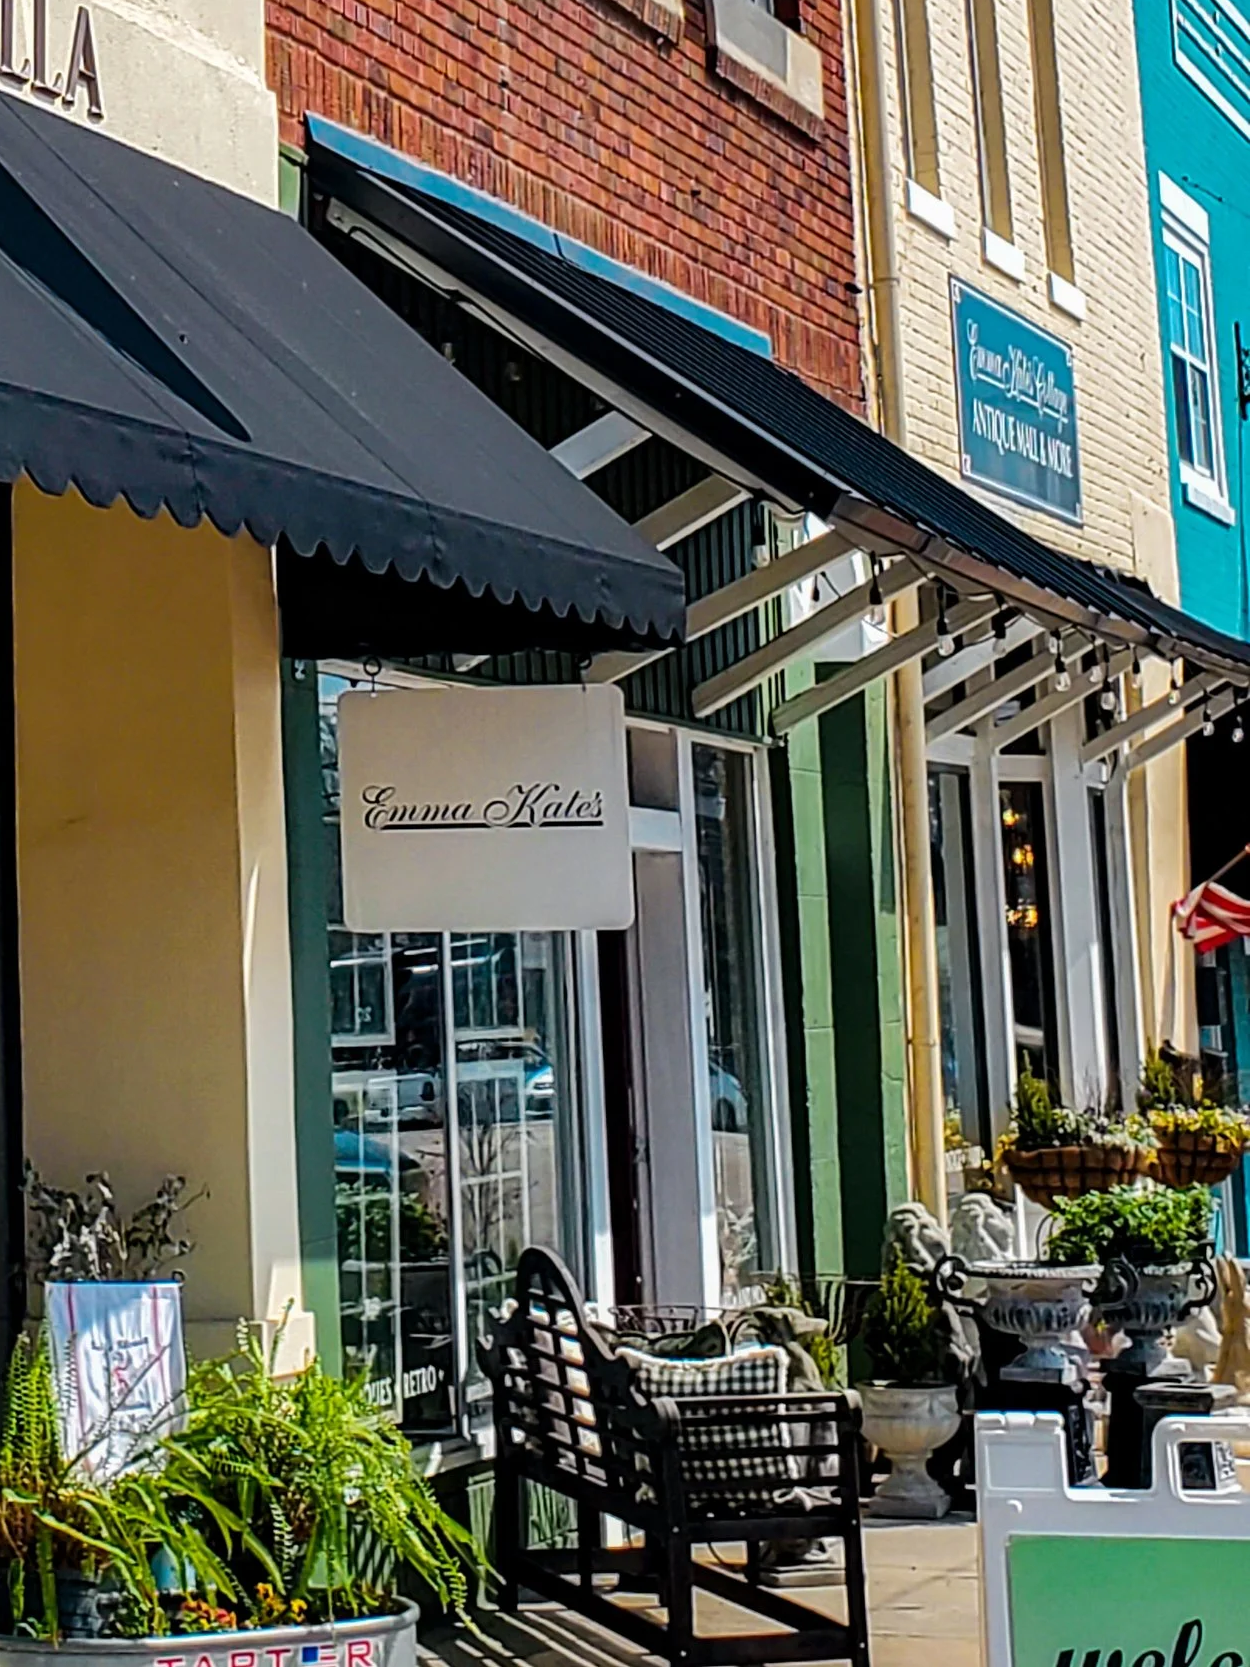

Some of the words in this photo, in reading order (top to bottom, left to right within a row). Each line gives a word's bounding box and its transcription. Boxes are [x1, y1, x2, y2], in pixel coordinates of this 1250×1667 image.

[973, 398, 1016, 455] ANTIQUE
[1016, 420, 1039, 462] MALL
[1047, 435, 1073, 478] MORE
[362, 785, 472, 830] Emma
[483, 783, 603, 828] Kate's
